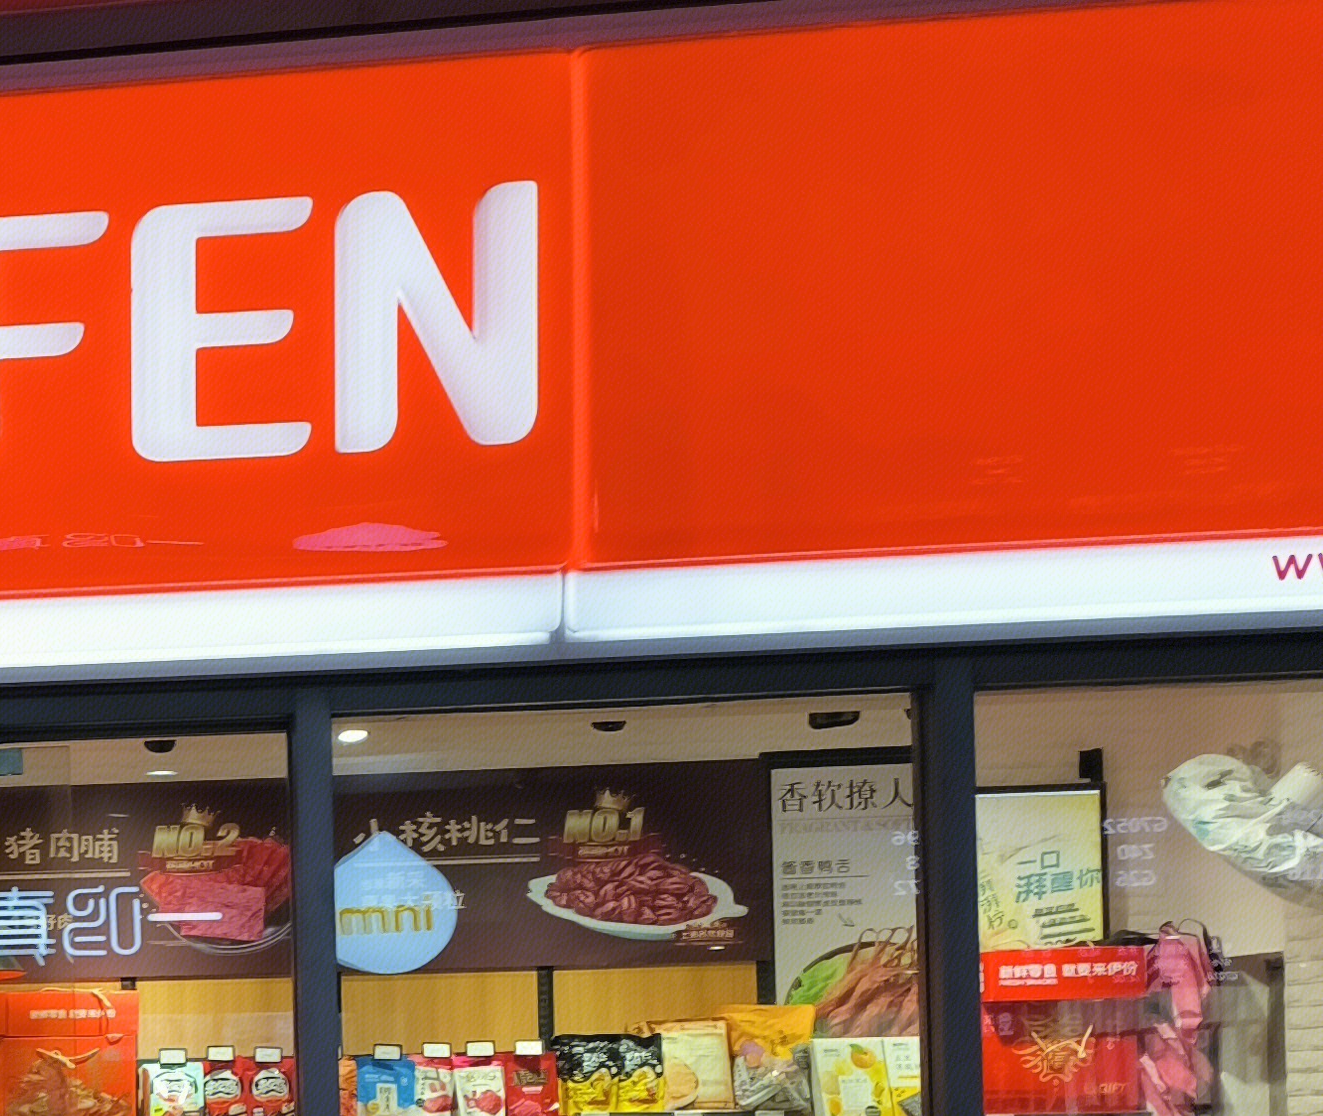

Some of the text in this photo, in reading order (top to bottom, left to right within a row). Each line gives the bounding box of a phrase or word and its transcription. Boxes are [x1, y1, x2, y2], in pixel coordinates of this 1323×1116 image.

[1272, 552, 1323, 581] w
[778, 777, 914, 812] 香软撩人
[152, 822, 241, 859] NO.2
[563, 806, 646, 844] NO.1
